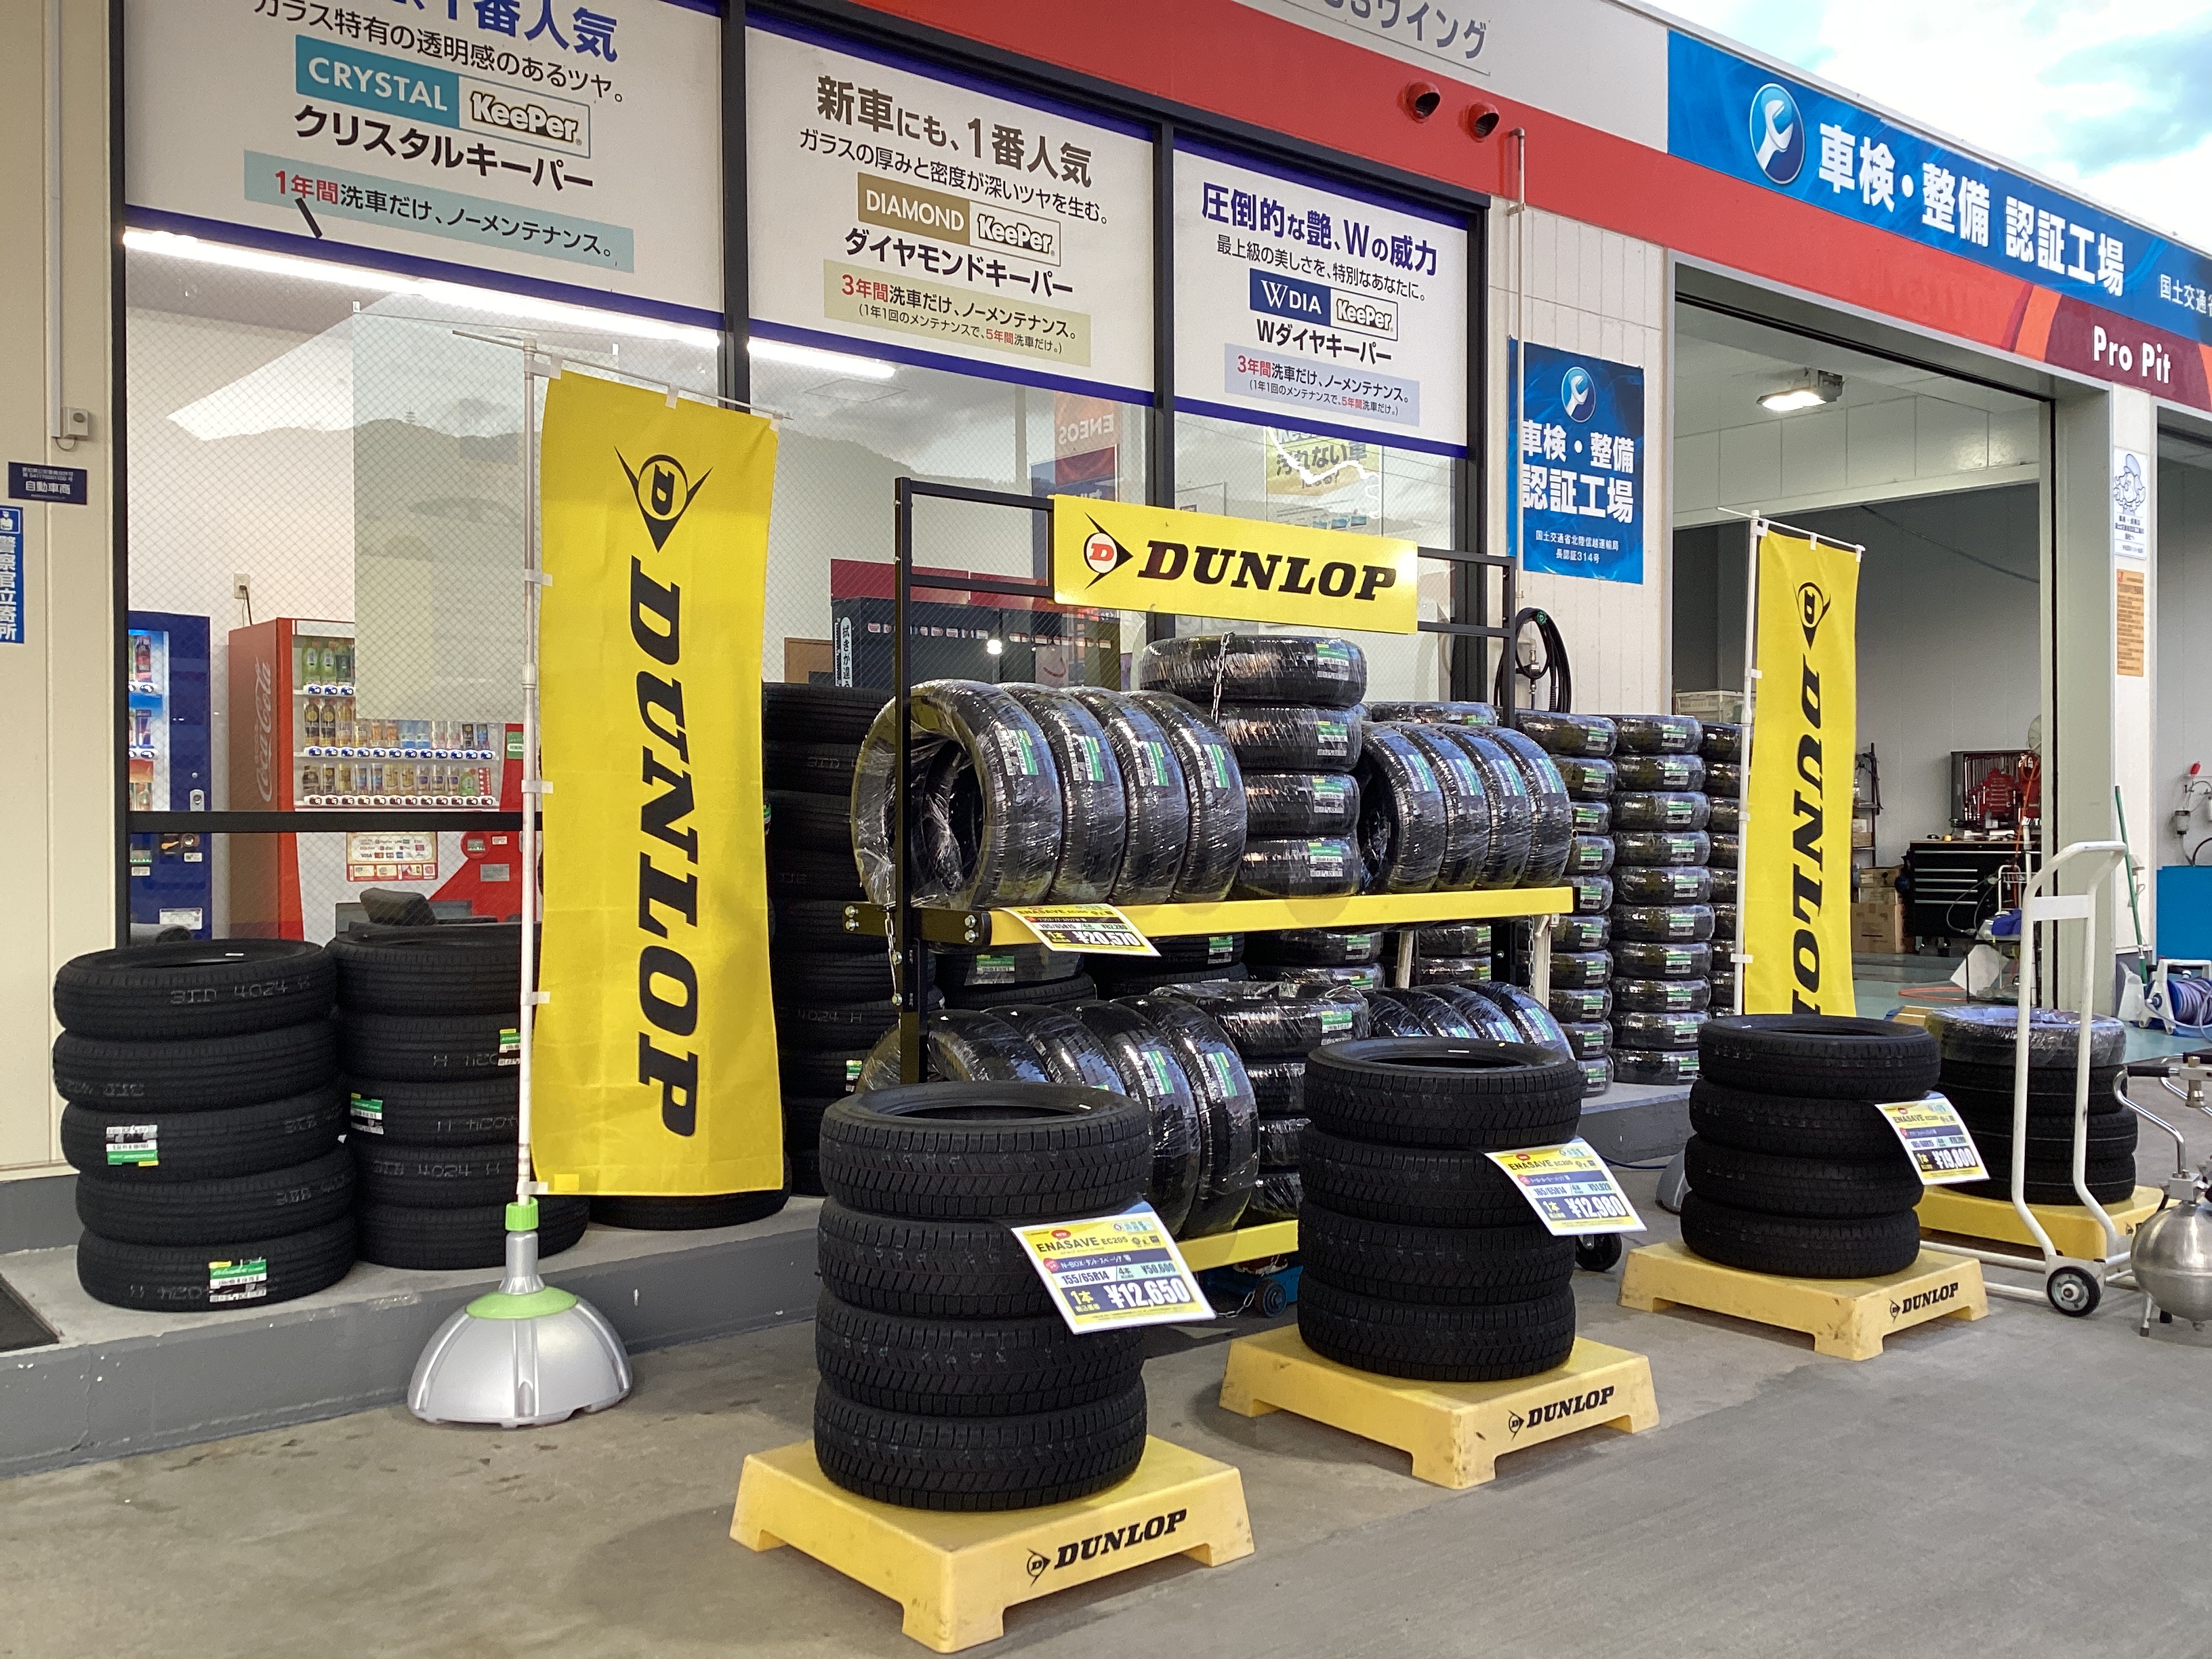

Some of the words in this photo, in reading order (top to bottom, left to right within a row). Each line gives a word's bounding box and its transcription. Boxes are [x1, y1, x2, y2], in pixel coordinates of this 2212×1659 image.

[1326, 0, 1486, 59] ウイング
[308, 58, 448, 111] CRYSTAL
[470, 88, 578, 143] KeePer
[294, 106, 594, 192] クリスタルキーパー
[817, 75, 1092, 188] 新車にも、1番人気
[800, 129, 1108, 225] ガラスの厚みと密度が深いツヤを生む。
[274, 169, 613, 258] 1年間洗車だけ、ノーメンテナンス。
[866, 189, 965, 232] DIAMOND
[977, 214, 1052, 254] KeePer
[1202, 182, 1437, 276] 圧倒的な艶、Wの威力
[1818, 123, 1991, 248] 車検・整備
[2006, 196, 2125, 297] 認証工場
[844, 228, 1073, 298] ダイヤモンドキーパー
[1216, 234, 1426, 302] 最上級の美しさを、特別なあなたに。
[841, 274, 1076, 340] 3年間洗車だけ、ノーメンテナンス。
[1336, 295, 1392, 331] KeePer
[2160, 274, 2212, 318] 国土交通
[1256, 319, 1393, 365] Wダイヤキーパー
[2093, 325, 2133, 371] Pro
[2142, 342, 2171, 384] Pit
[1237, 355, 1409, 404] 3年間洗車だけ、ノーメンテナンス。
[1523, 419, 1635, 474] 車検・整備
[1522, 463, 1634, 524] 認証工場
[1138, 539, 1397, 601] DUNLOP
[630, 554, 699, 1138] DUNLOP
[1072, 931, 1141, 946] ¥20,570
[1892, 1114, 1925, 1123] ENASAVE
[1508, 1160, 1553, 1171] ENASAVE
[1931, 1147, 1976, 1170] ¥19,800
[1564, 1195, 1626, 1219] ¥12,980
[1036, 1237, 1100, 1253] ENASAVE
[1101, 1236, 1128, 1246] EC205
[1061, 1270, 1110, 1285] 155/65R14
[1071, 1290, 1094, 1305] 1本
[1103, 1277, 1191, 1309] ¥12,650
[1902, 1282, 1959, 1315] DUNLOP
[1526, 1386, 1616, 1429] DUNLOP
[1054, 1509, 1187, 1570] DUNLOP
